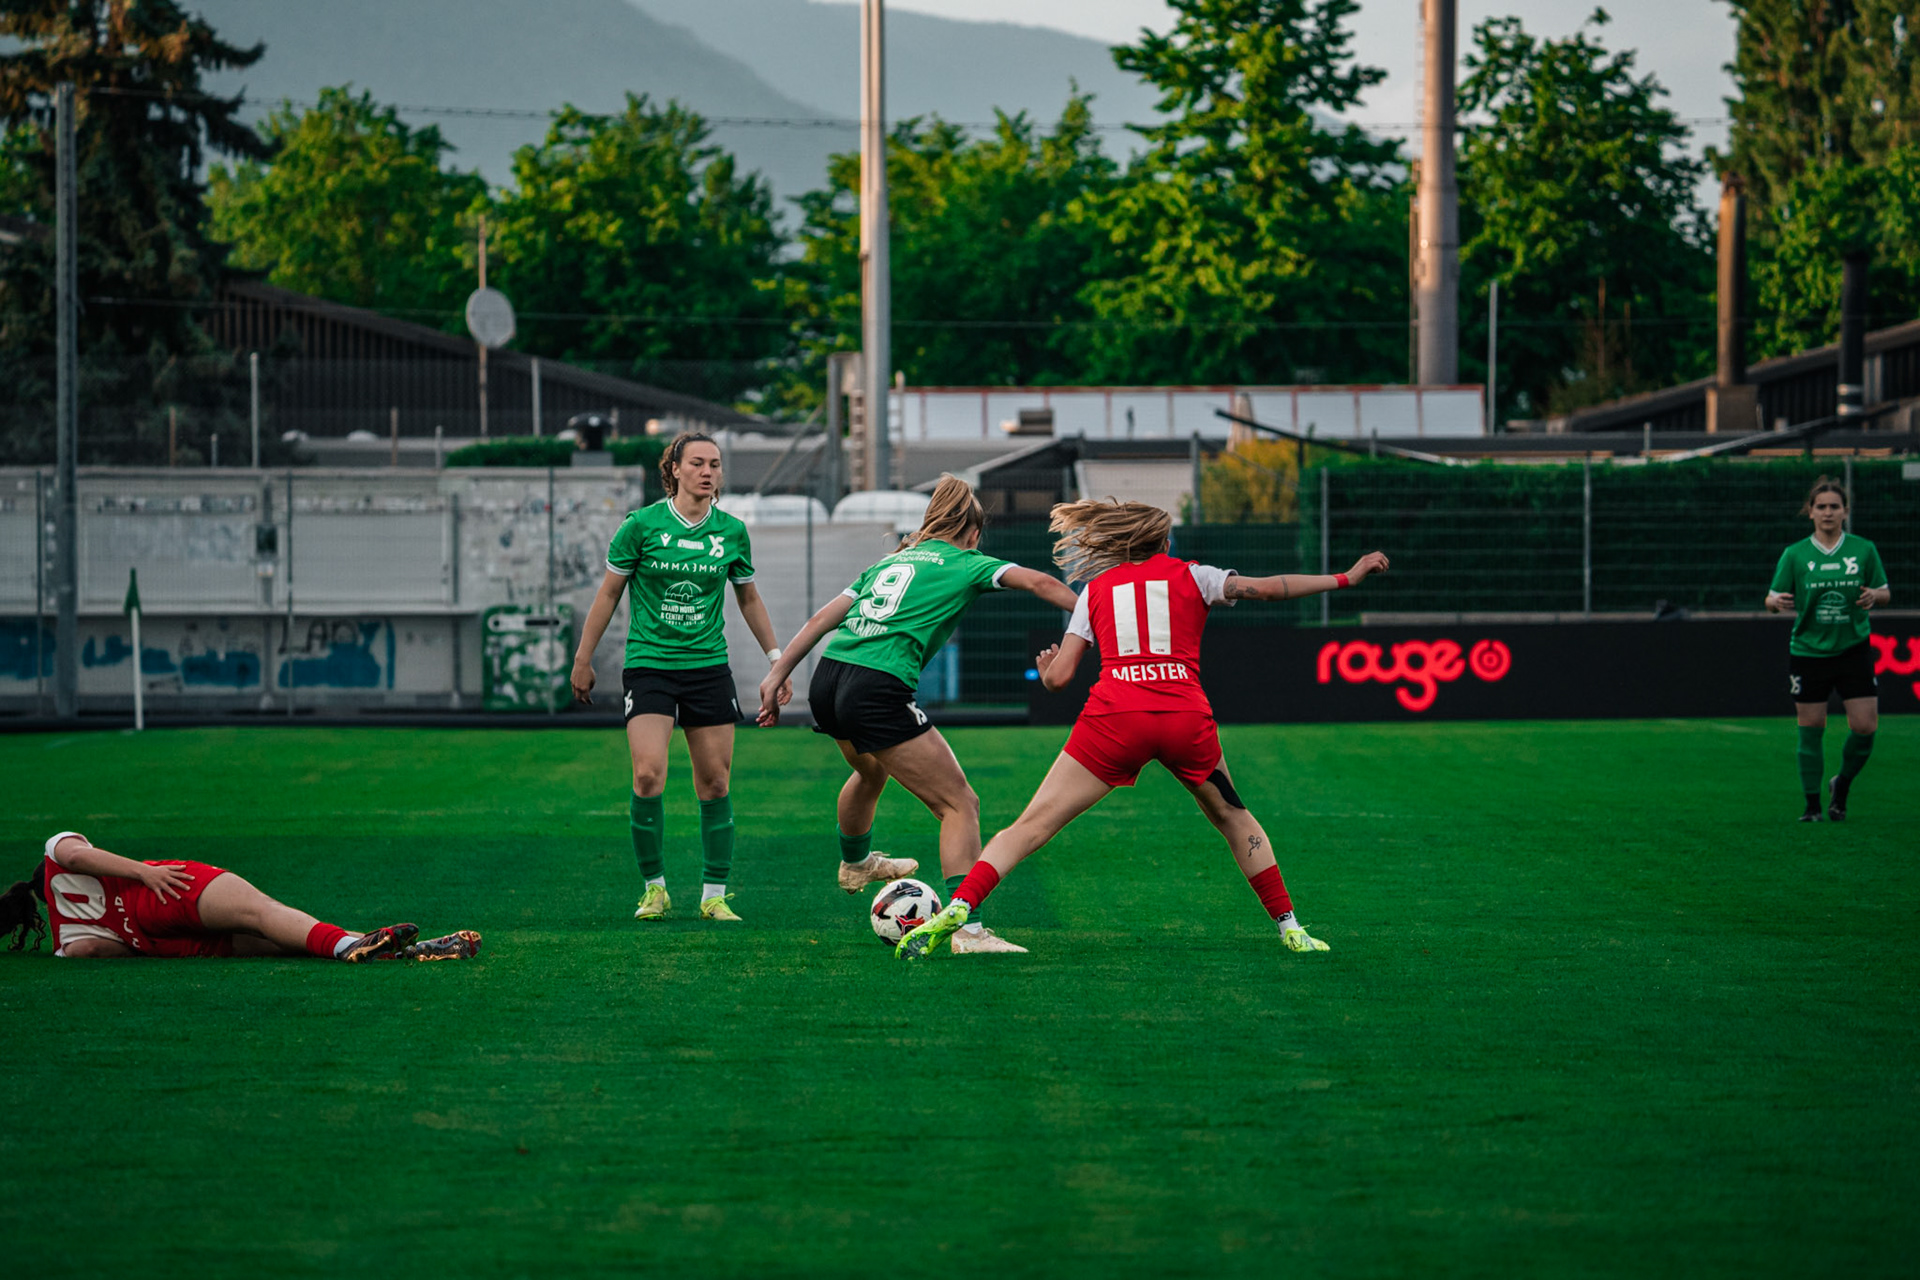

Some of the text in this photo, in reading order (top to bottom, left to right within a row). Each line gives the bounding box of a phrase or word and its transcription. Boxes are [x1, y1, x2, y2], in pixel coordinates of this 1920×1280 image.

[661, 603, 679, 613] GRAND
[859, 562, 916, 622] 9
[1112, 579, 1172, 657] 11
[1111, 663, 1189, 683] MEISTER
[1317, 639, 1466, 712] rouge
